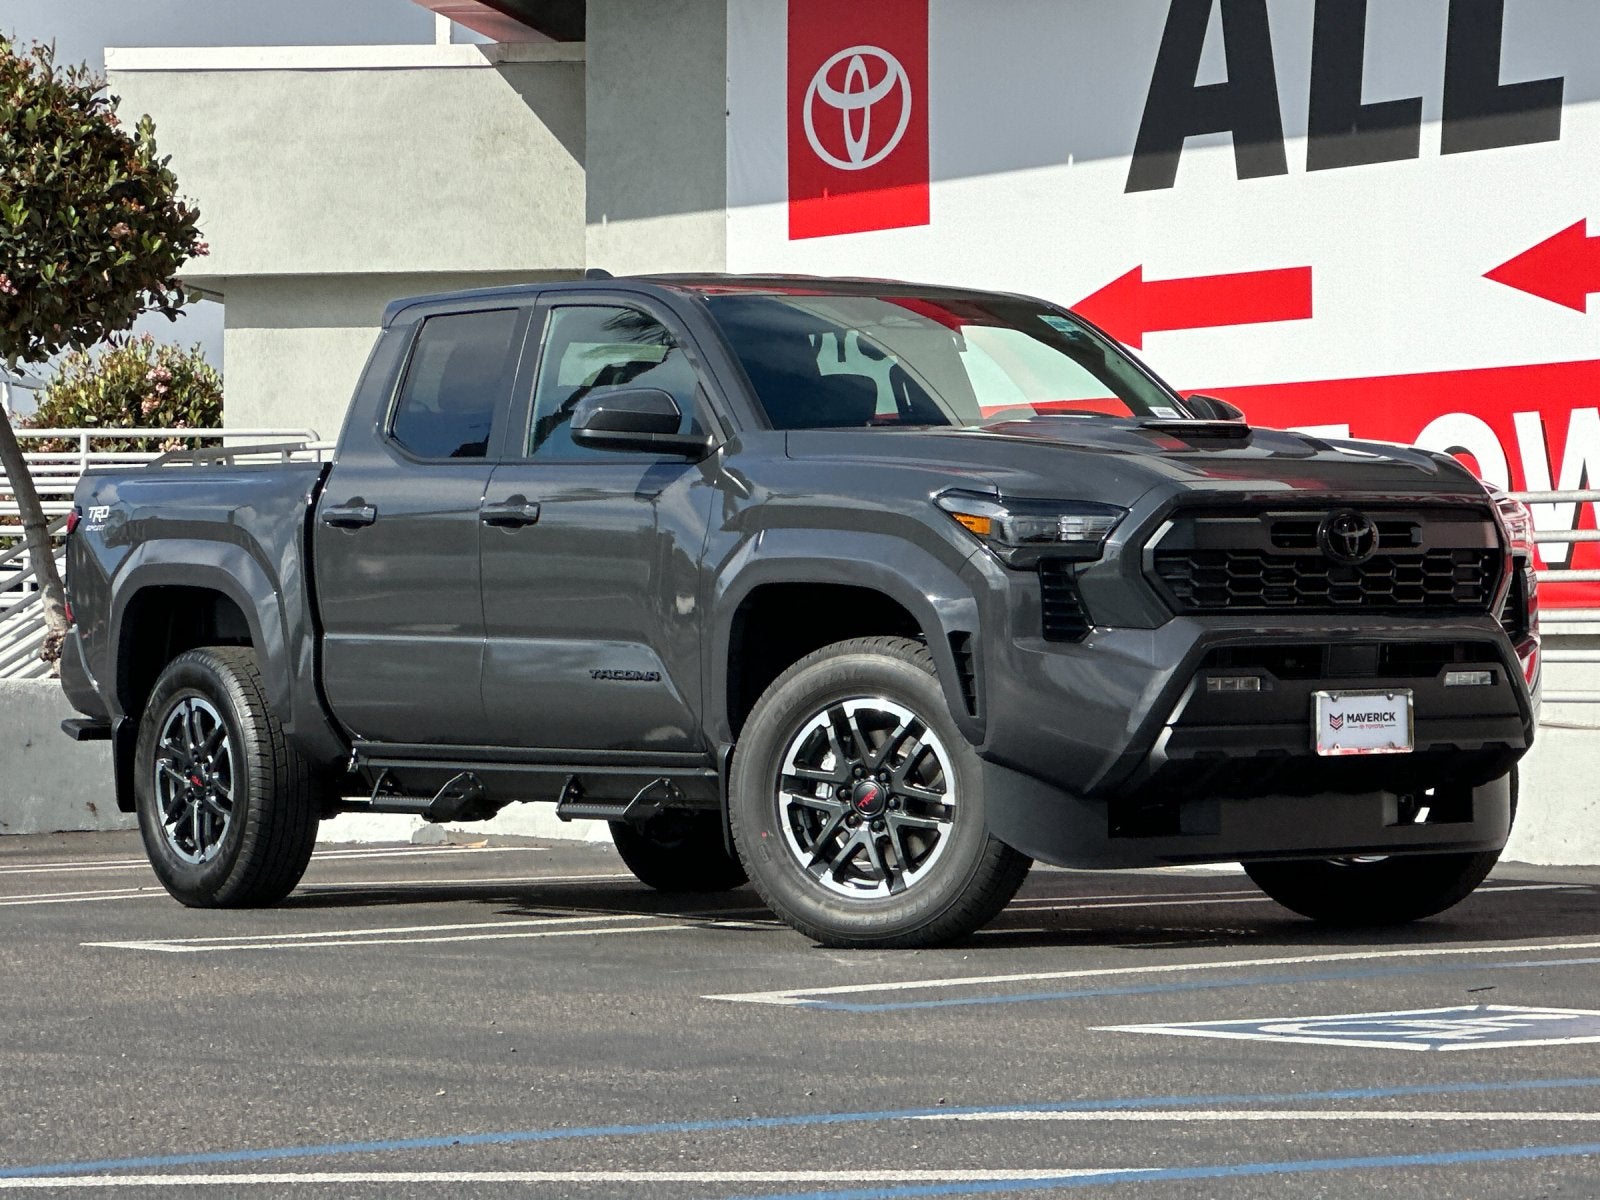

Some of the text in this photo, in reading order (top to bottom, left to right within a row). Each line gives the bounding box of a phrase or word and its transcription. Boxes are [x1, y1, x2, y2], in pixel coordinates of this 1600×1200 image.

[1124, 0, 1564, 193] ALL
[88, 506, 109, 522] TRD
[589, 670, 661, 681] TACOMA
[1346, 712, 1396, 723] MAVERICK
